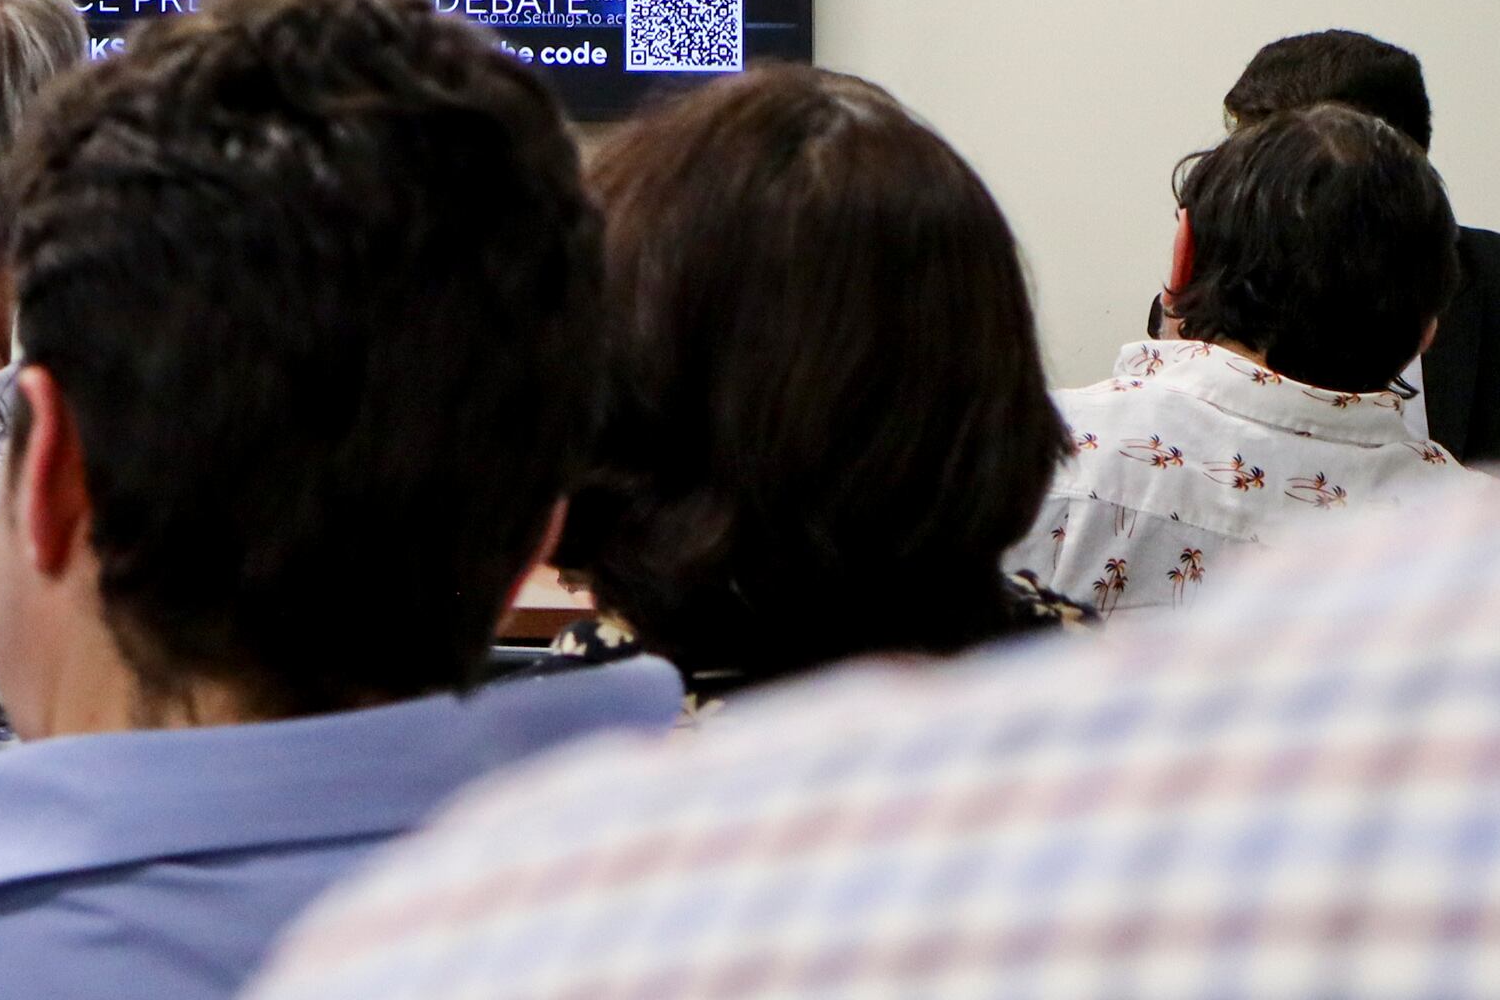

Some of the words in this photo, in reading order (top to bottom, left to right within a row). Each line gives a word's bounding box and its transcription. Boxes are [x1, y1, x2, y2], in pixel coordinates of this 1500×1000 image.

[587, 11, 602, 25] to
[607, 12, 627, 25] ac
[501, 41, 535, 65] he
[540, 41, 608, 65] code
